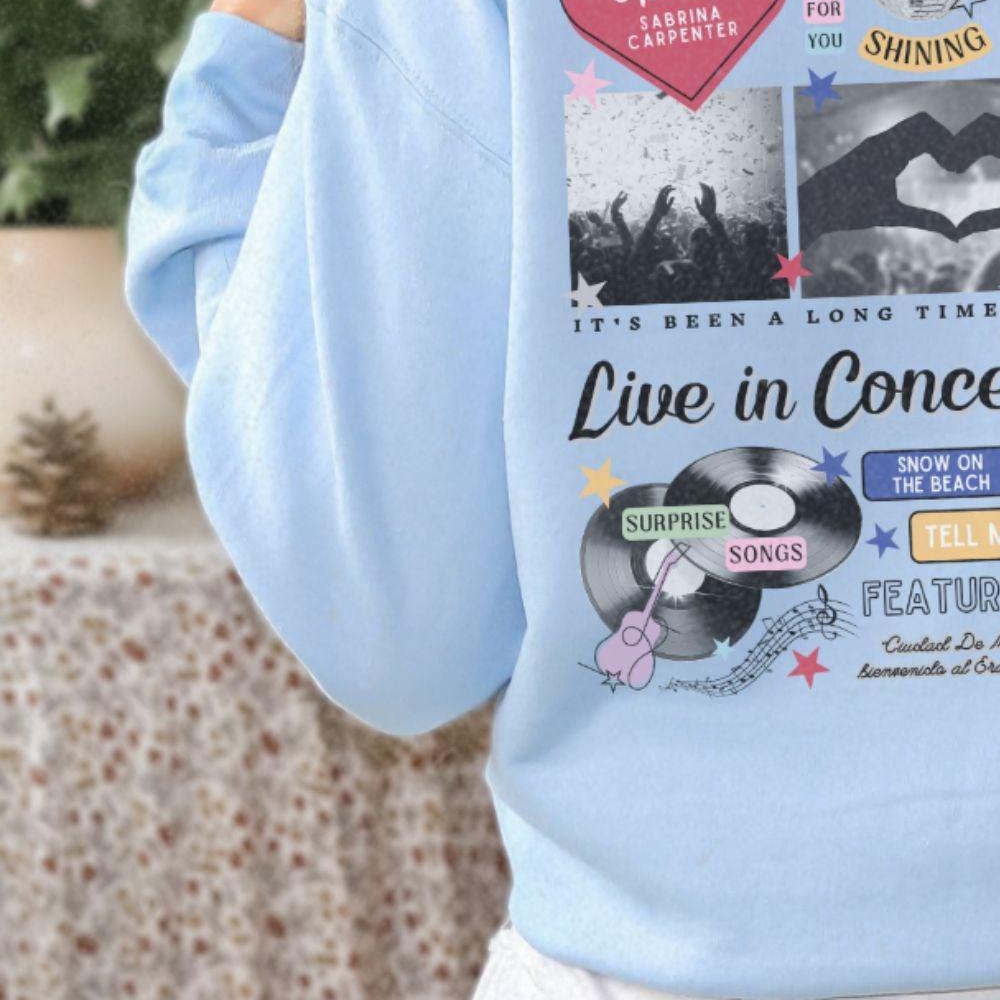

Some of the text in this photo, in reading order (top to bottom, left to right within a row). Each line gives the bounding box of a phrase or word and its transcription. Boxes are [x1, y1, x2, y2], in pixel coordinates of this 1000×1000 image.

[639, 5, 722, 31] SABRINA
[806, 0, 842, 18] FOR
[627, 21, 739, 50] CARPENTER
[807, 32, 843, 50] YOU
[864, 26, 988, 66] SHINING
[573, 316, 641, 333] IT'S
[664, 312, 746, 329] BEEN
[768, 311, 784, 326] A
[806, 307, 893, 325] LONG
[916, 303, 998, 319] TIME
[568, 360, 716, 441] Live
[735, 366, 798, 423] in
[897, 454, 984, 473] SNOW ON
[892, 474, 991, 494] THE BEACH
[625, 511, 727, 533] SURPRISE
[925, 523, 979, 548] TELL
[729, 543, 803, 564] SONGS
[954, 632, 985, 652] De
[950, 658, 972, 675] al
